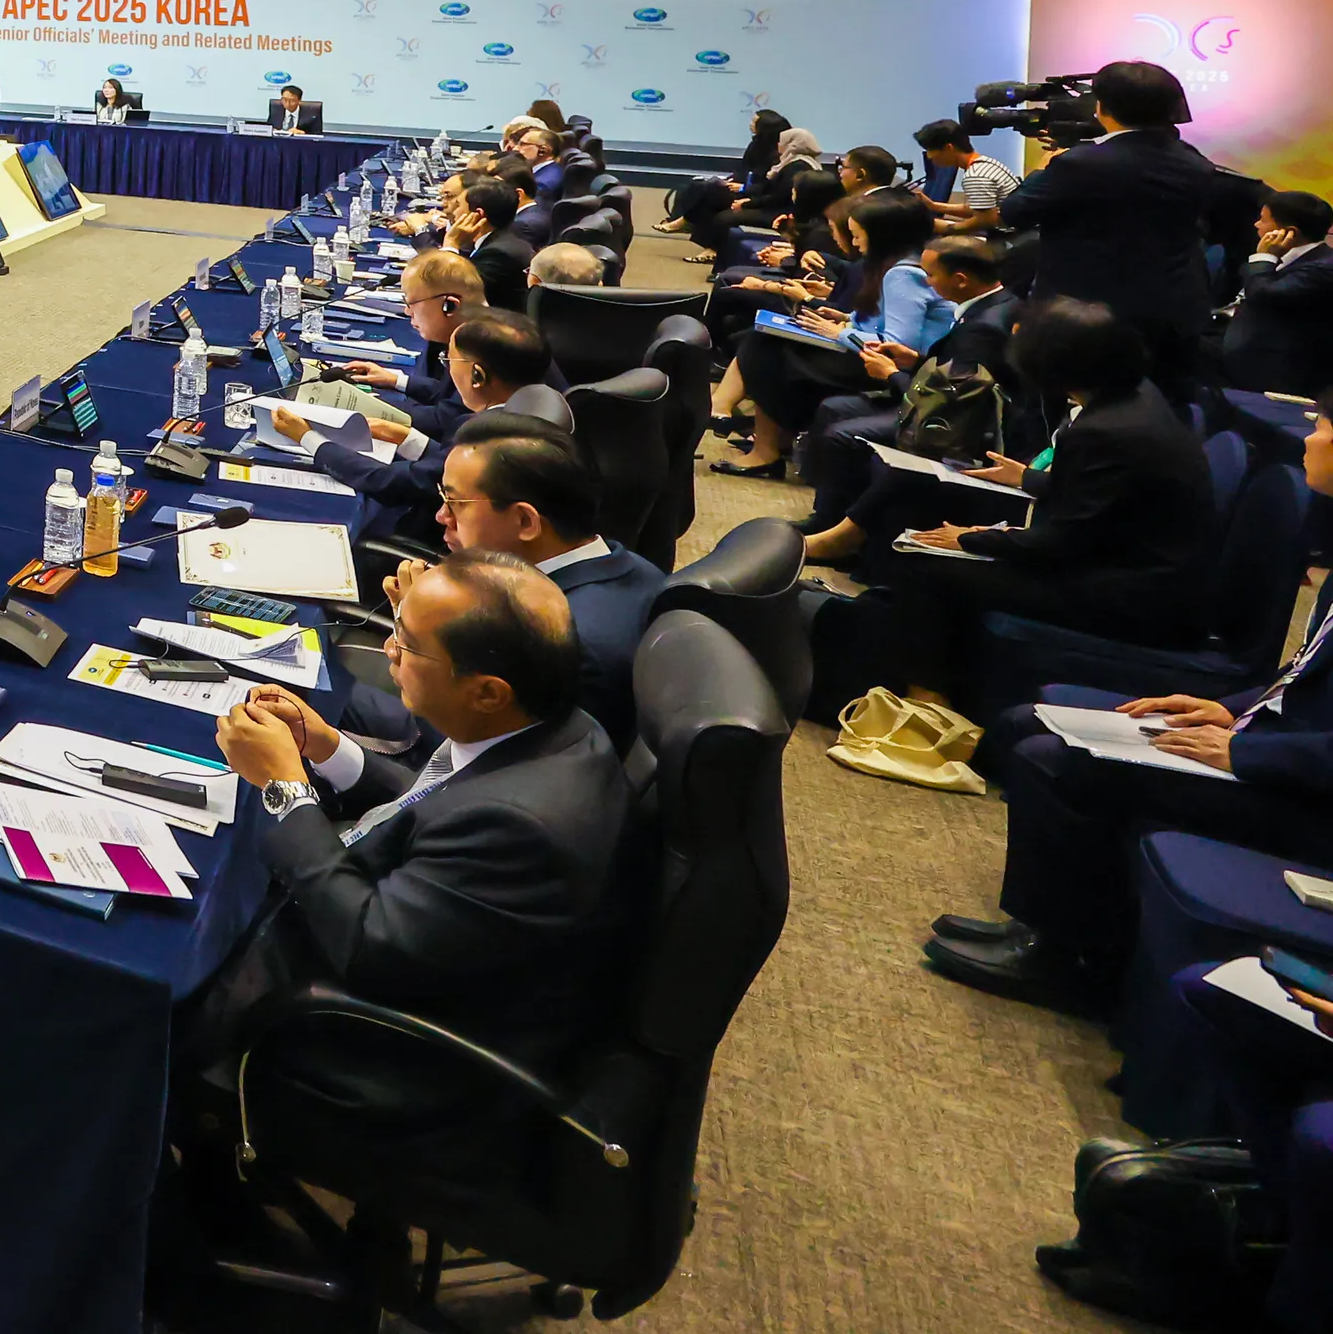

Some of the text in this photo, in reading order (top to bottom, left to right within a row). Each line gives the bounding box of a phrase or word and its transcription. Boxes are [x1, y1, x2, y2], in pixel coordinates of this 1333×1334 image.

[98, 28, 159, 50] Meeting
[161, 32, 191, 48] and
[194, 33, 253, 51] Related
[256, 35, 333, 57] Meetings
[1185, 70, 1229, 82] 2025
[351, 830, 363, 842] APEC
